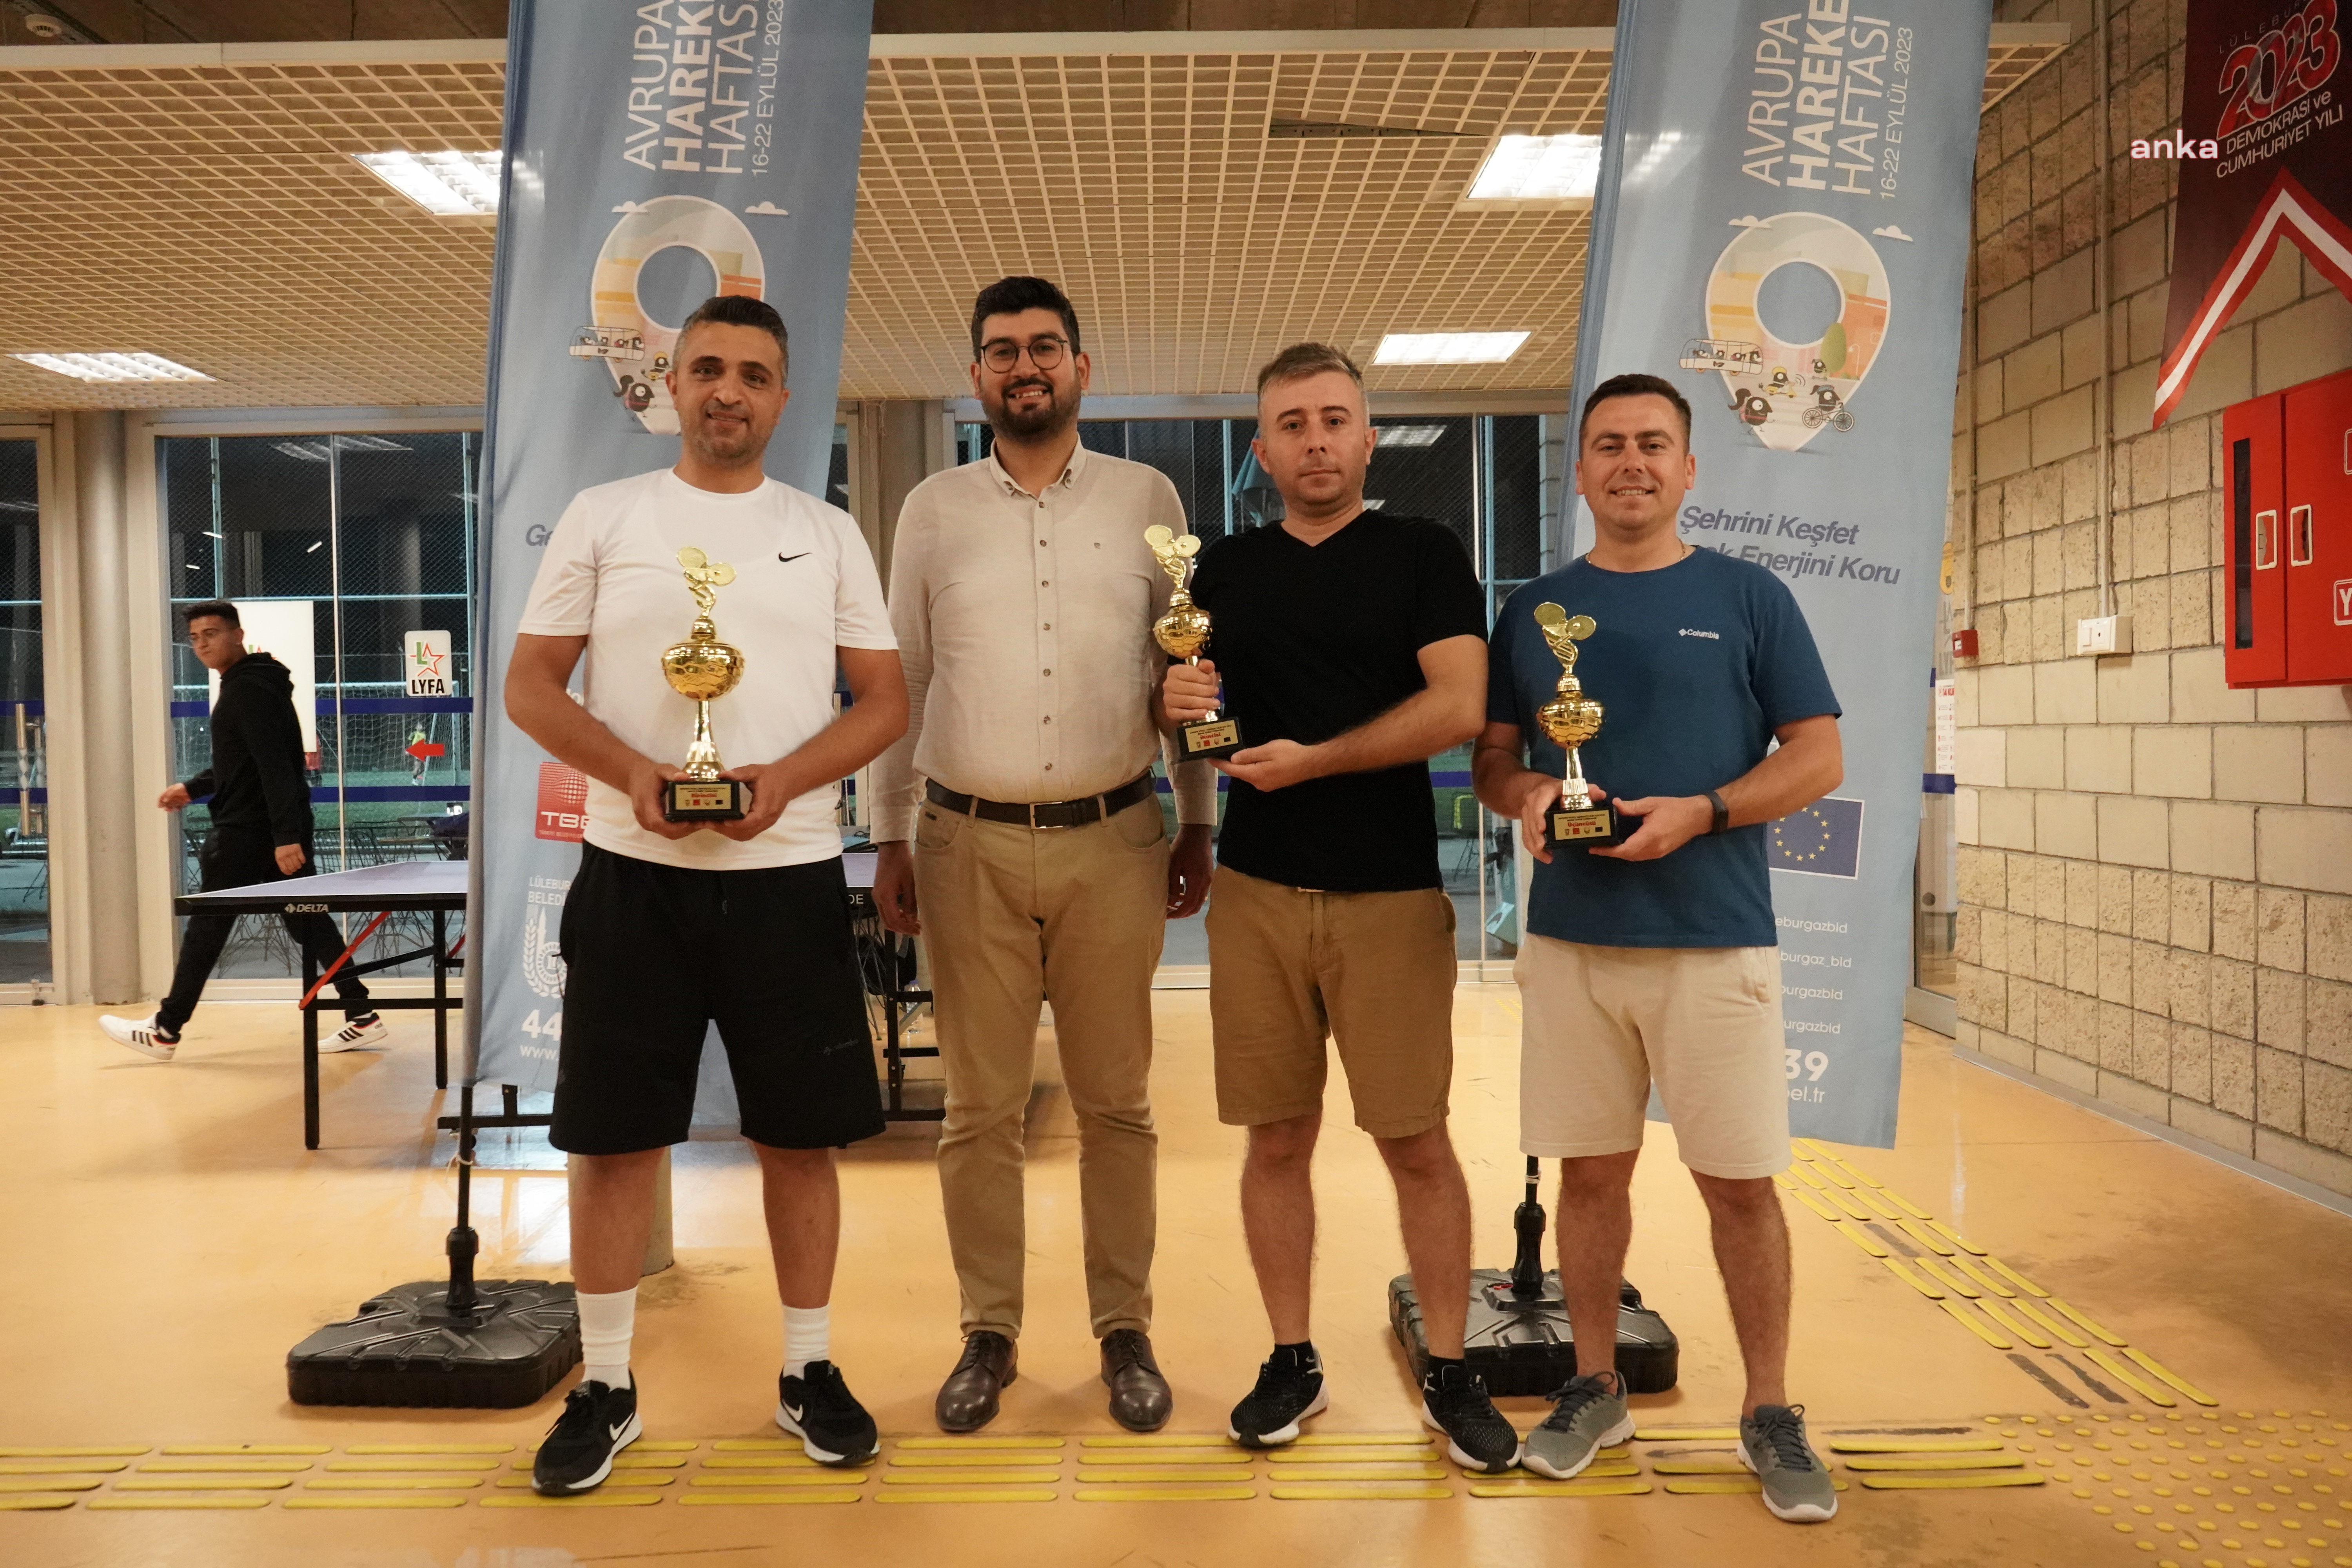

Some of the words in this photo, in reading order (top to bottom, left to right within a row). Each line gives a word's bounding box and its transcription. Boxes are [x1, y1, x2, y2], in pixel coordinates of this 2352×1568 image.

[765, 0, 784, 46] 2023
[1894, 27, 1913, 74] 2023
[2216, 0, 2340, 141] 2023
[624, 0, 674, 171] AVRUPA
[662, 0, 715, 171] HAREK
[706, 0, 759, 173] HAFTAS
[757, 51, 779, 118] EYLÜL
[1742, 13, 1802, 187] AVRUPA
[1831, 16, 1890, 195] HAFTASI
[1886, 80, 1908, 144] EYLÜL
[2227, 94, 2310, 154] DEMOKRASİ
[2313, 91, 2331, 109] ve
[751, 123, 771, 176] 16-22
[2217, 119, 2312, 178] CUMHURİYET
[2315, 103, 2343, 130] YILI
[1880, 149, 1900, 199] 16-22
[1680, 506, 1774, 535] Şehrini
[1776, 515, 1860, 547] Keşfet
[1838, 556, 1901, 584] Koru
[1687, 629, 1719, 640] Columbia
[412, 679, 445, 694] LYFA
[296, 904, 329, 913] DELTA
[521, 1009, 562, 1041] 44
[1785, 1048, 1828, 1082] 39
[1788, 1086, 1826, 1103] el.tr
